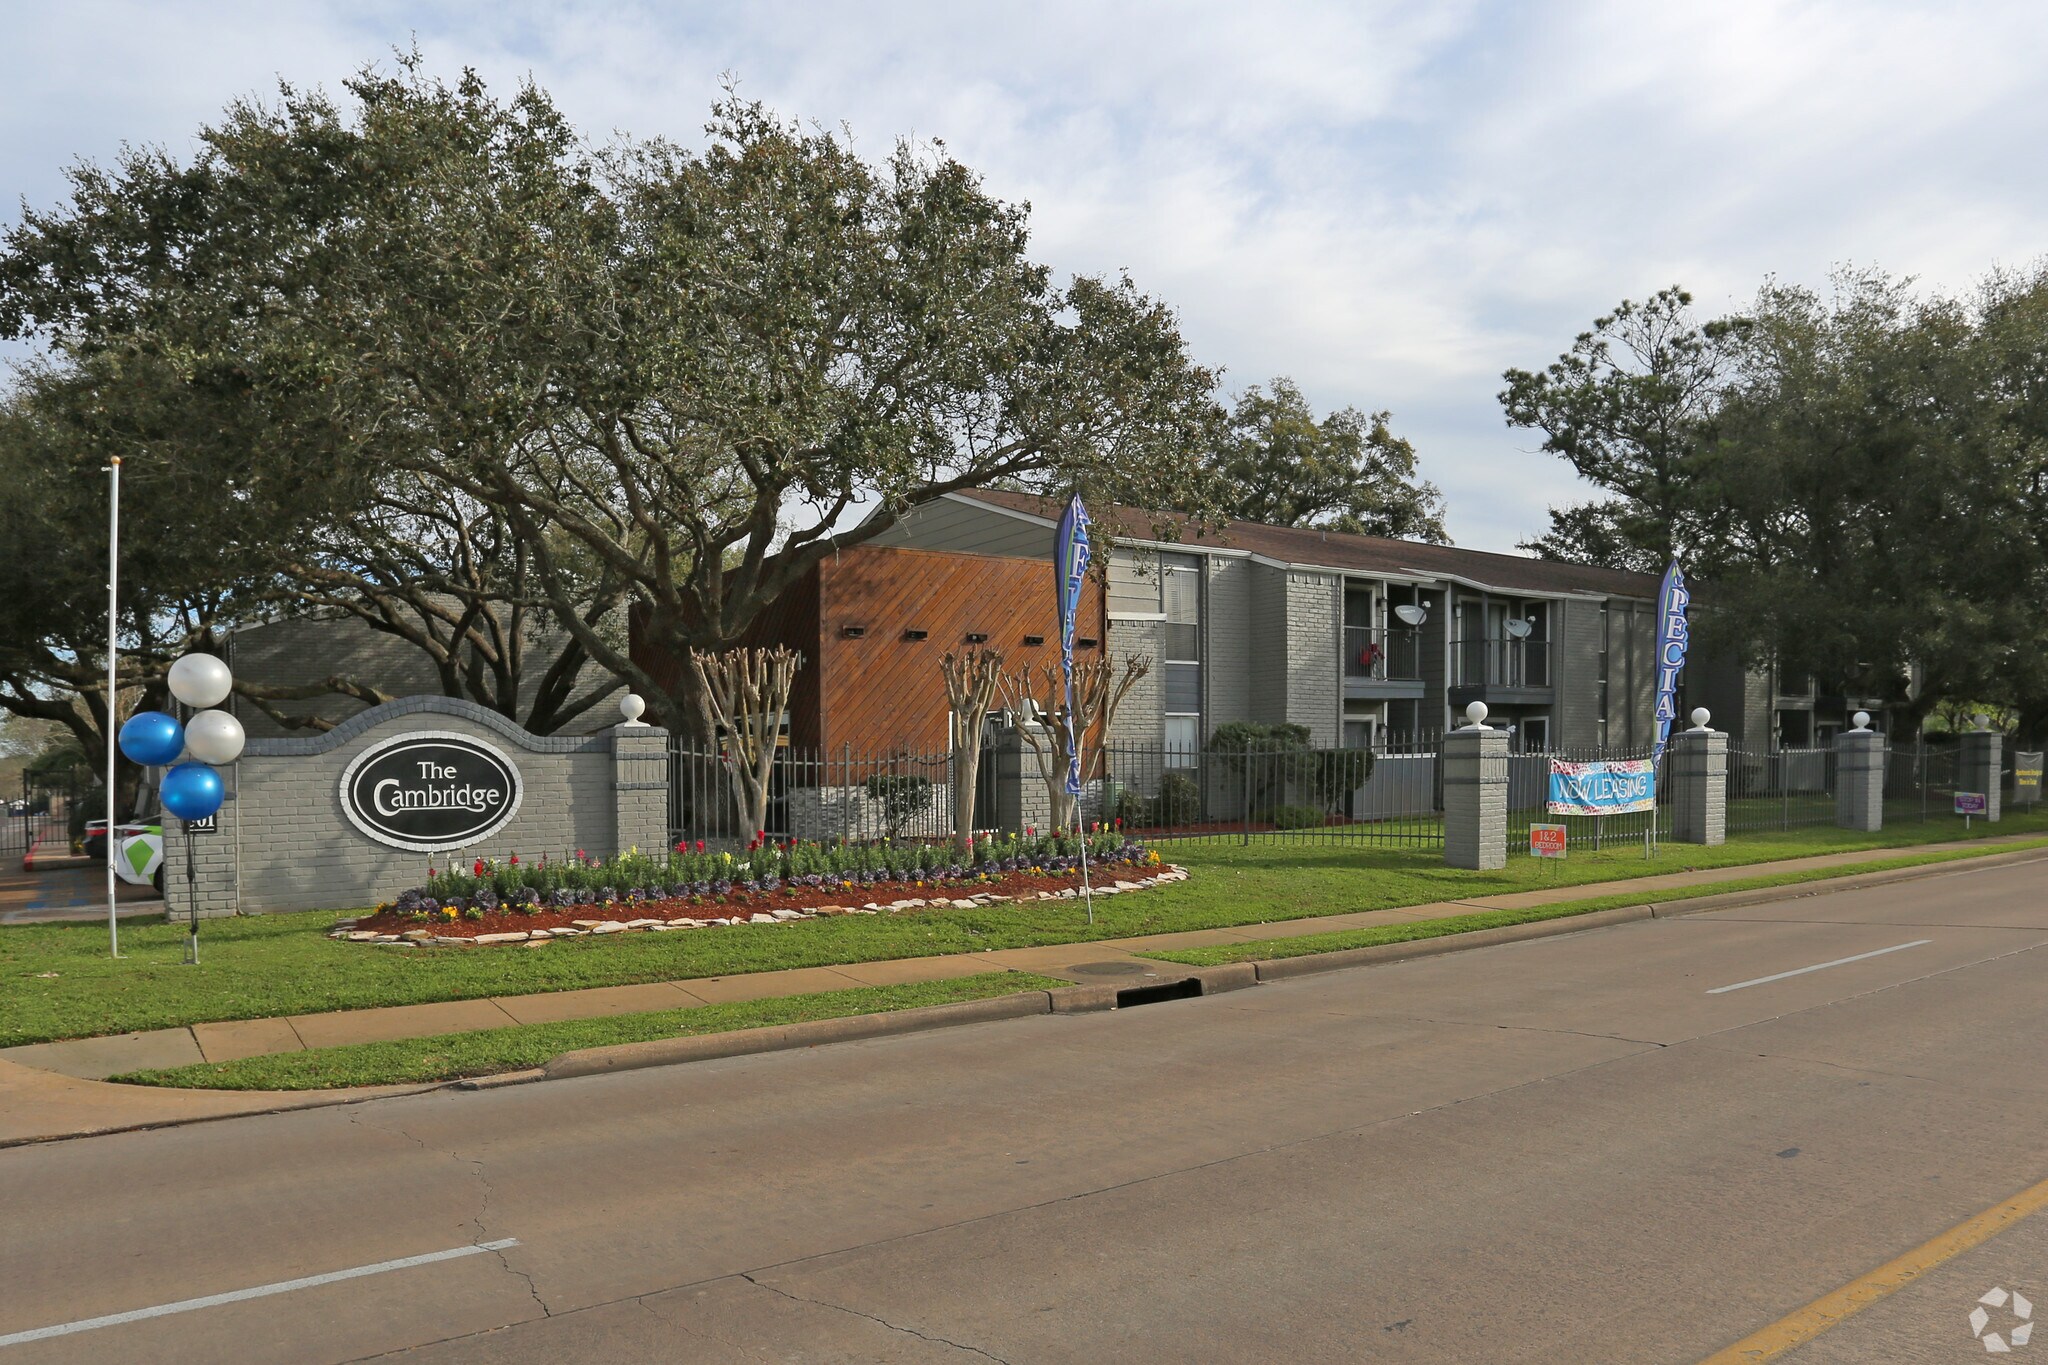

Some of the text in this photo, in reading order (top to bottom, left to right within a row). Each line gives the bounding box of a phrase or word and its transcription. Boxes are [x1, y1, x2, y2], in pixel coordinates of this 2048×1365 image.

[417, 761, 457, 779] The
[1559, 775, 1647, 800] NOW LEASING
[373, 778, 500, 817] Cambridge
[1534, 841, 1563, 850] BEDROOM
[1540, 831, 1557, 842] 1&2
